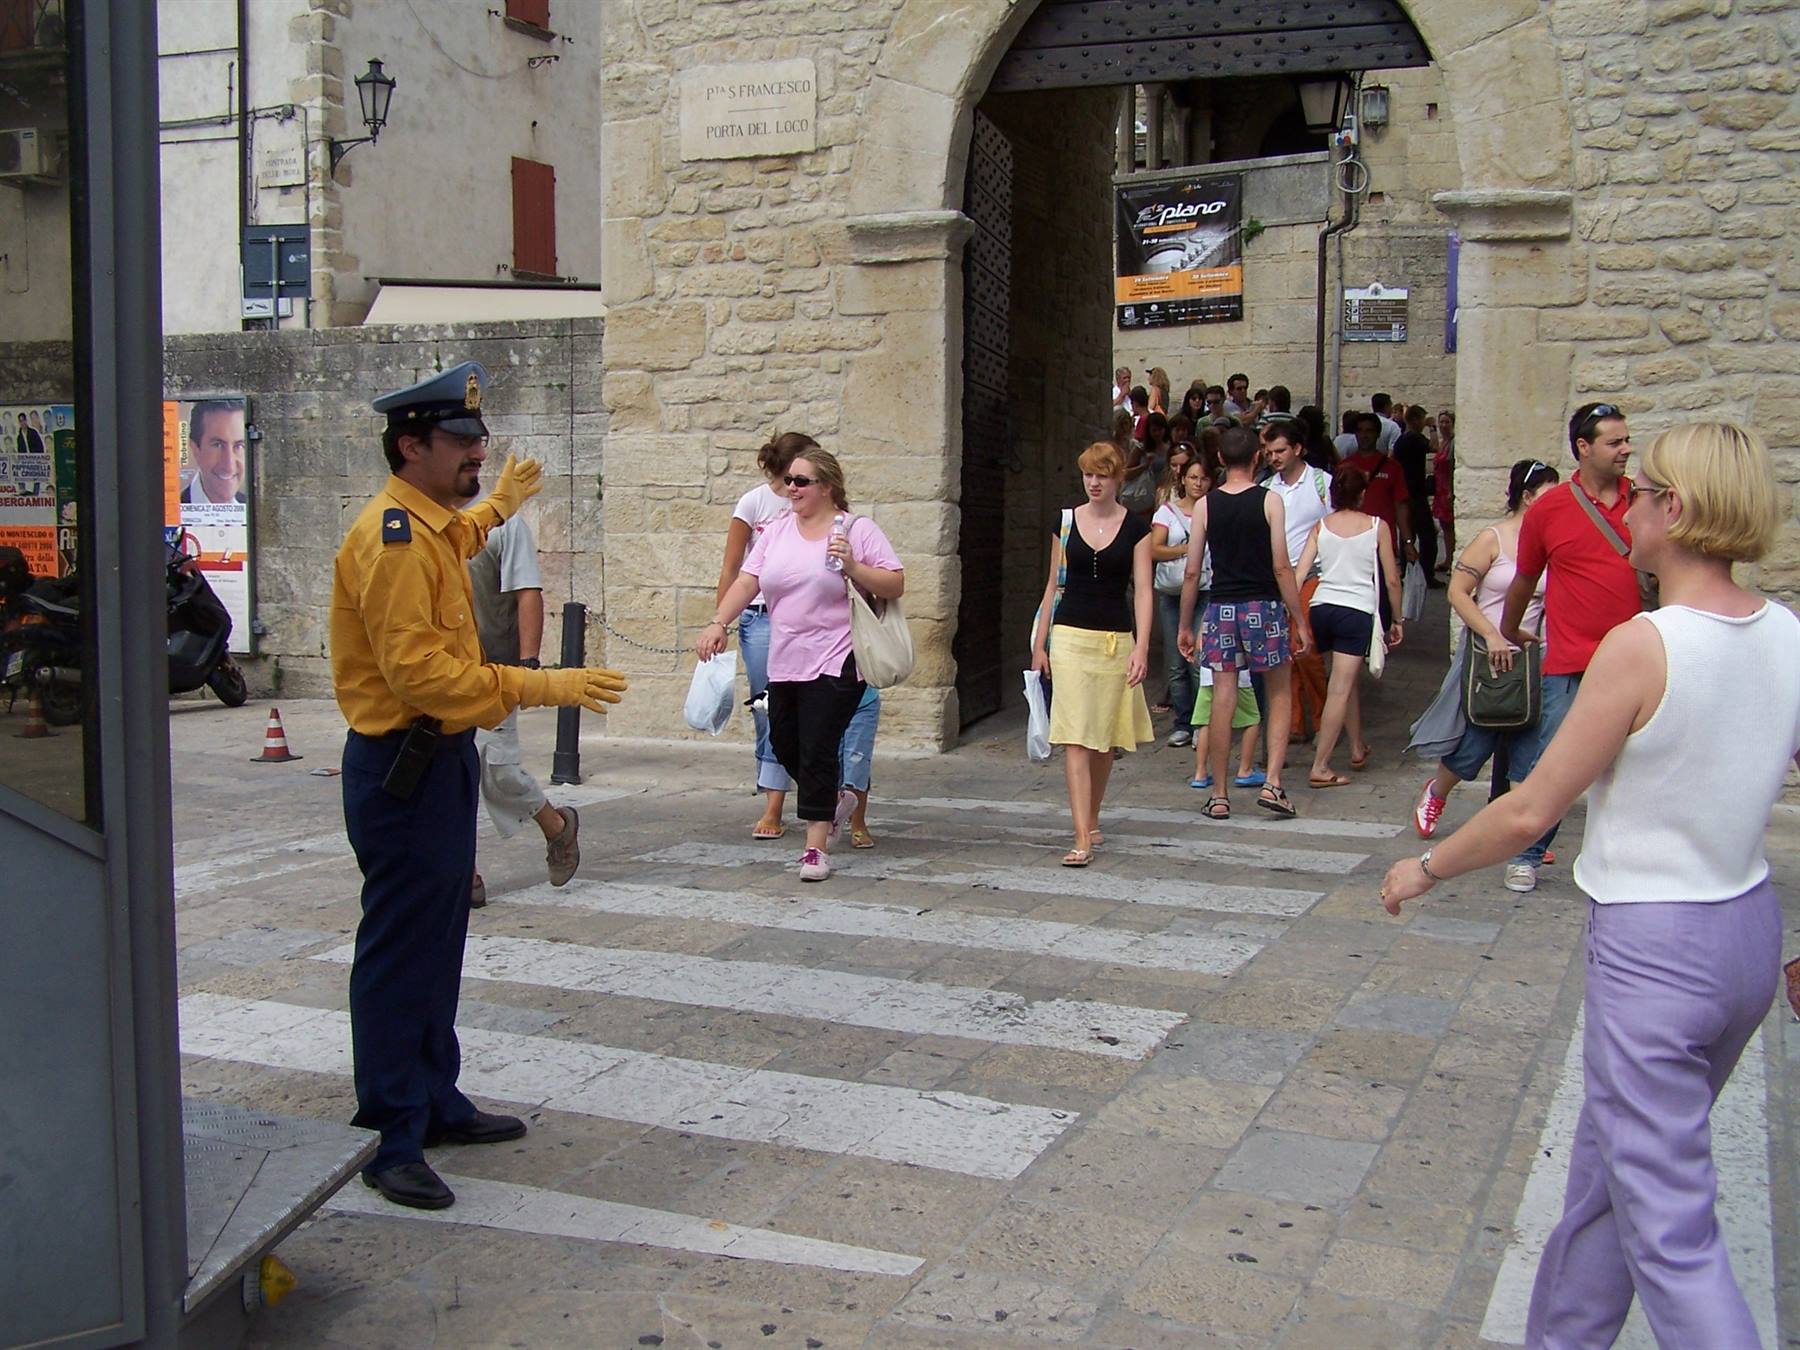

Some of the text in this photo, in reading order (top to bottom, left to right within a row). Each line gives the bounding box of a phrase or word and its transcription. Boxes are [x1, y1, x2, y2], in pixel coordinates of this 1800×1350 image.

[739, 79, 811, 98] FRANCESCO
[706, 119, 809, 139] PORTA DEL LOCO
[0, 497, 55, 507] BERGAMINI
